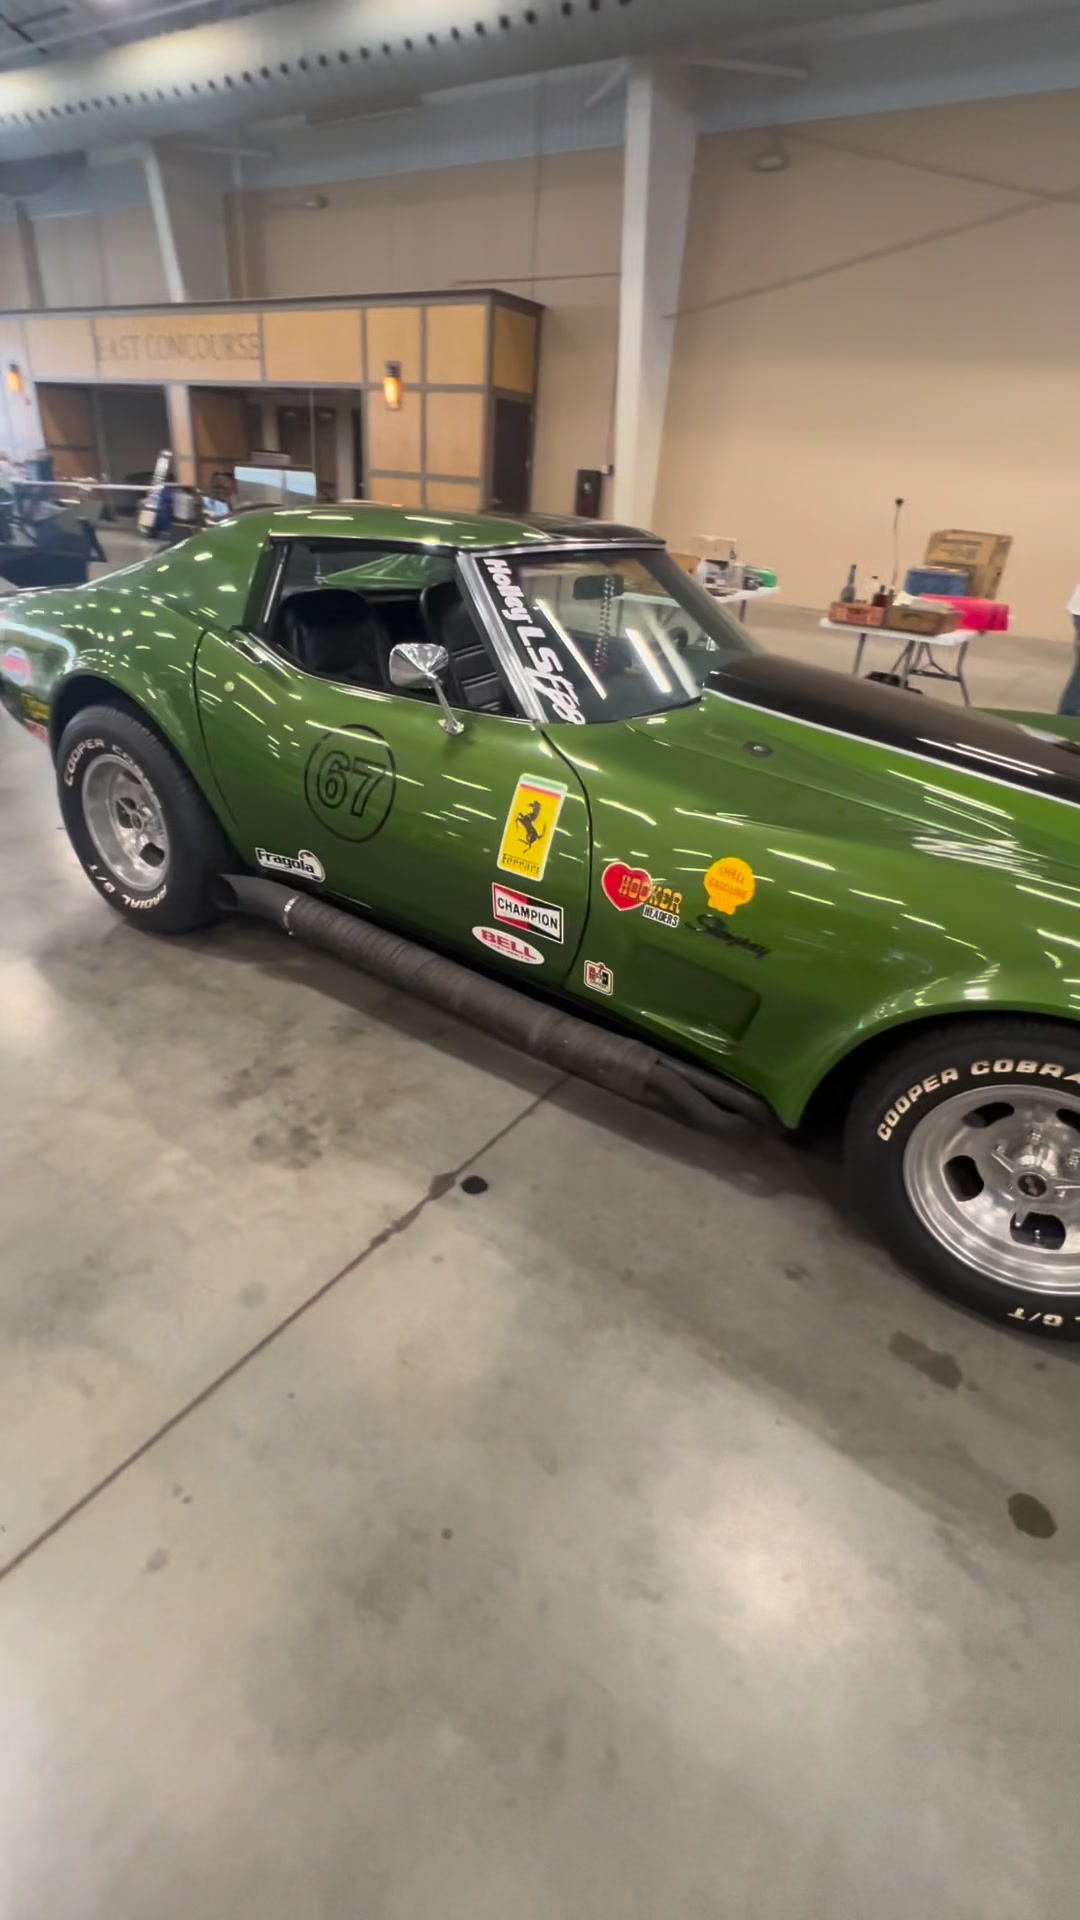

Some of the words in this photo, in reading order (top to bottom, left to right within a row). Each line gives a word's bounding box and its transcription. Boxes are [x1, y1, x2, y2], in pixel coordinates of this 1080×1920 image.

[97, 335, 140, 361] EAST
[146, 333, 261, 361] CONCOURSE
[483, 558, 533, 624] Holley
[64, 738, 105, 787] COOPER
[316, 749, 387, 817] 67
[257, 849, 315, 873] Fragola
[502, 852, 540, 874] Ferrari
[718, 865, 745, 885] SHELL
[122, 884, 168, 910] RADIAL
[618, 873, 682, 914] HOOKER
[497, 897, 558, 931] CHAMPION
[644, 904, 679, 927] HEADERS
[480, 929, 537, 960] BELL
[876, 1066, 960, 1142] COOPER
[1006, 1307, 1064, 1327] G/T
